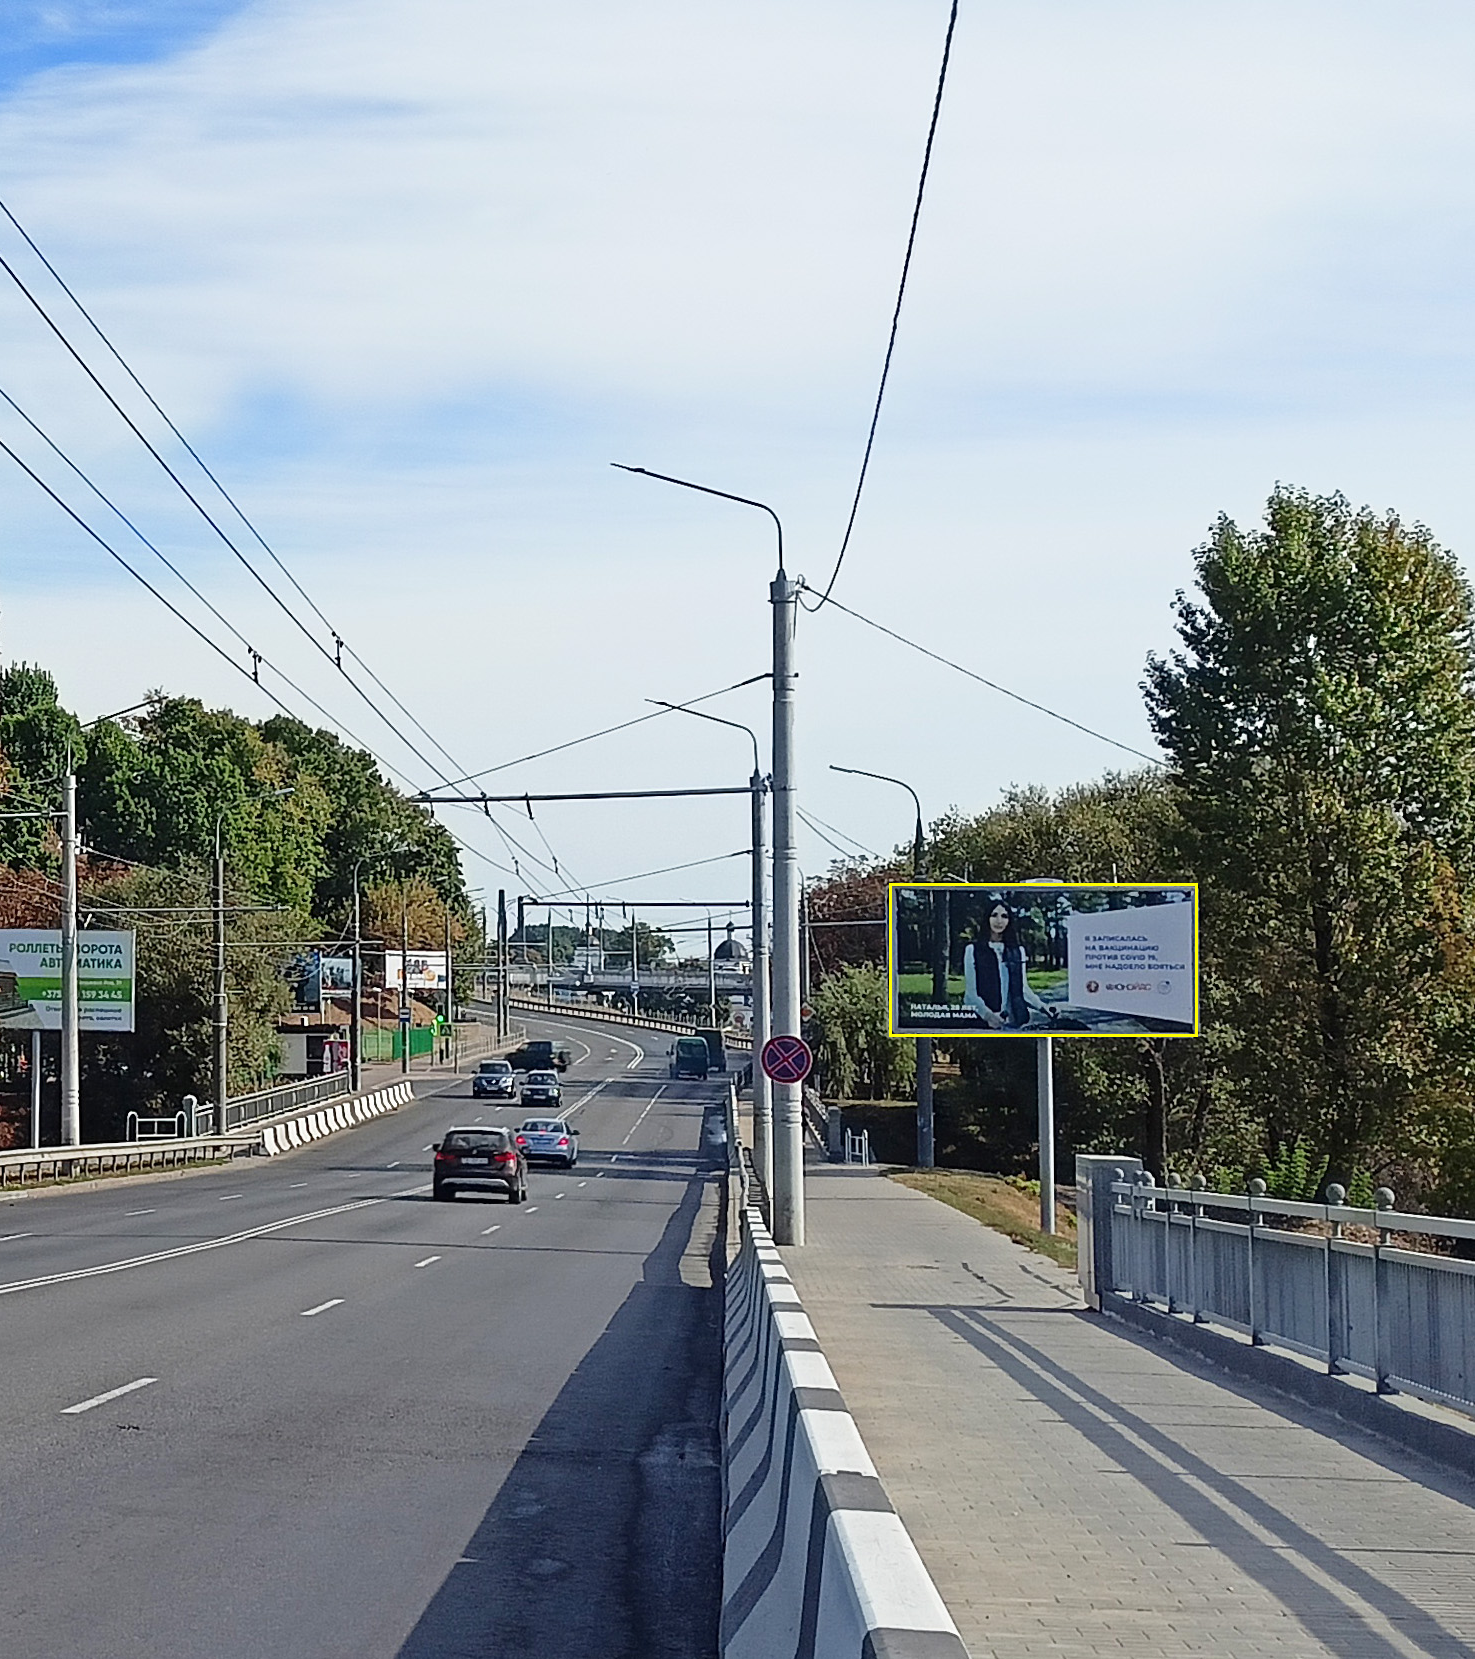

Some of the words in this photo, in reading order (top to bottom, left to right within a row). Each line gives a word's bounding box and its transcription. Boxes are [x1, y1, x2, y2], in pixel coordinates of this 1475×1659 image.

[1104, 963, 1146, 971] НАДОЕЛО
[1147, 963, 1186, 971] БОЯТЬСЯ
[910, 1003, 950, 1011] НАТАЛЬЯ,
[910, 1011, 951, 1019] МОЛОДАЯ
